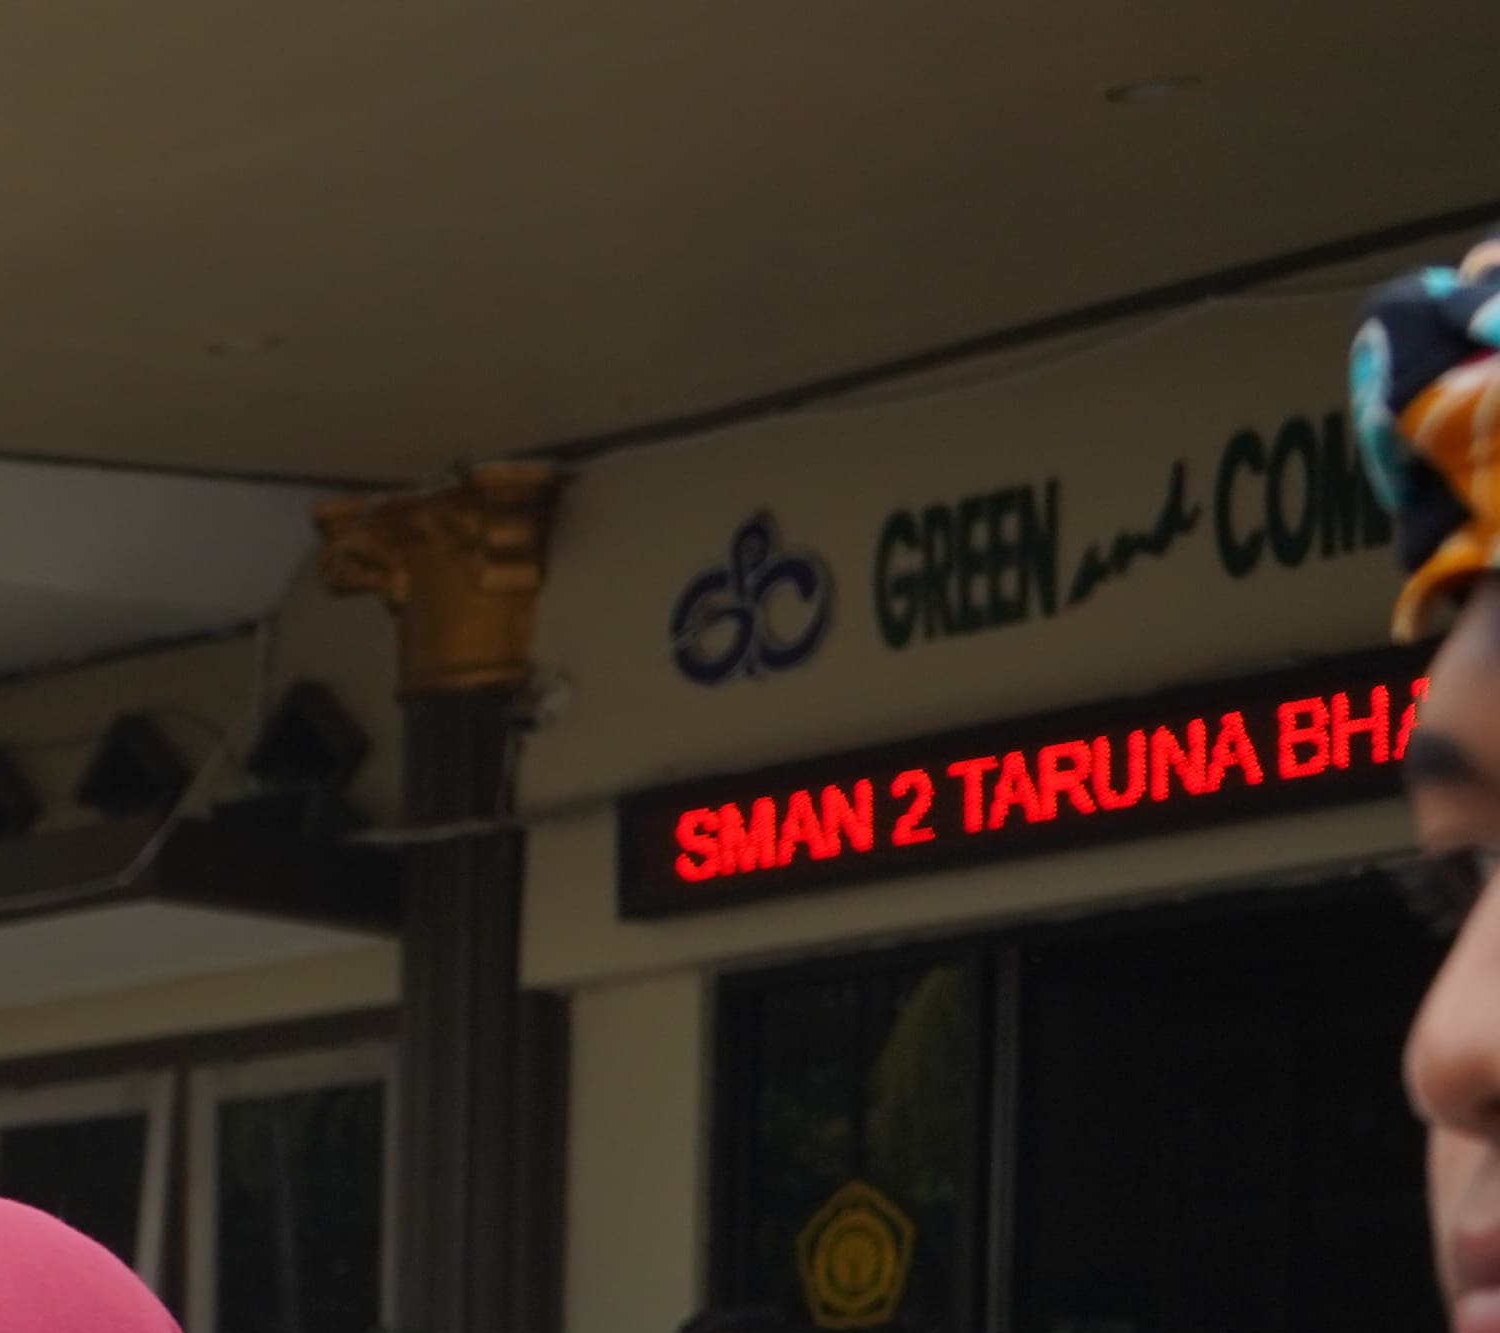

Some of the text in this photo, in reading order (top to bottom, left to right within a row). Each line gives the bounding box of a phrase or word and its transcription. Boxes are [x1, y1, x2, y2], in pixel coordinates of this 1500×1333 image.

[873, 478, 1060, 650] GREEN
[674, 779, 874, 883] SMAN
[891, 769, 935, 846] 2
[947, 710, 1264, 834] TARUNA
